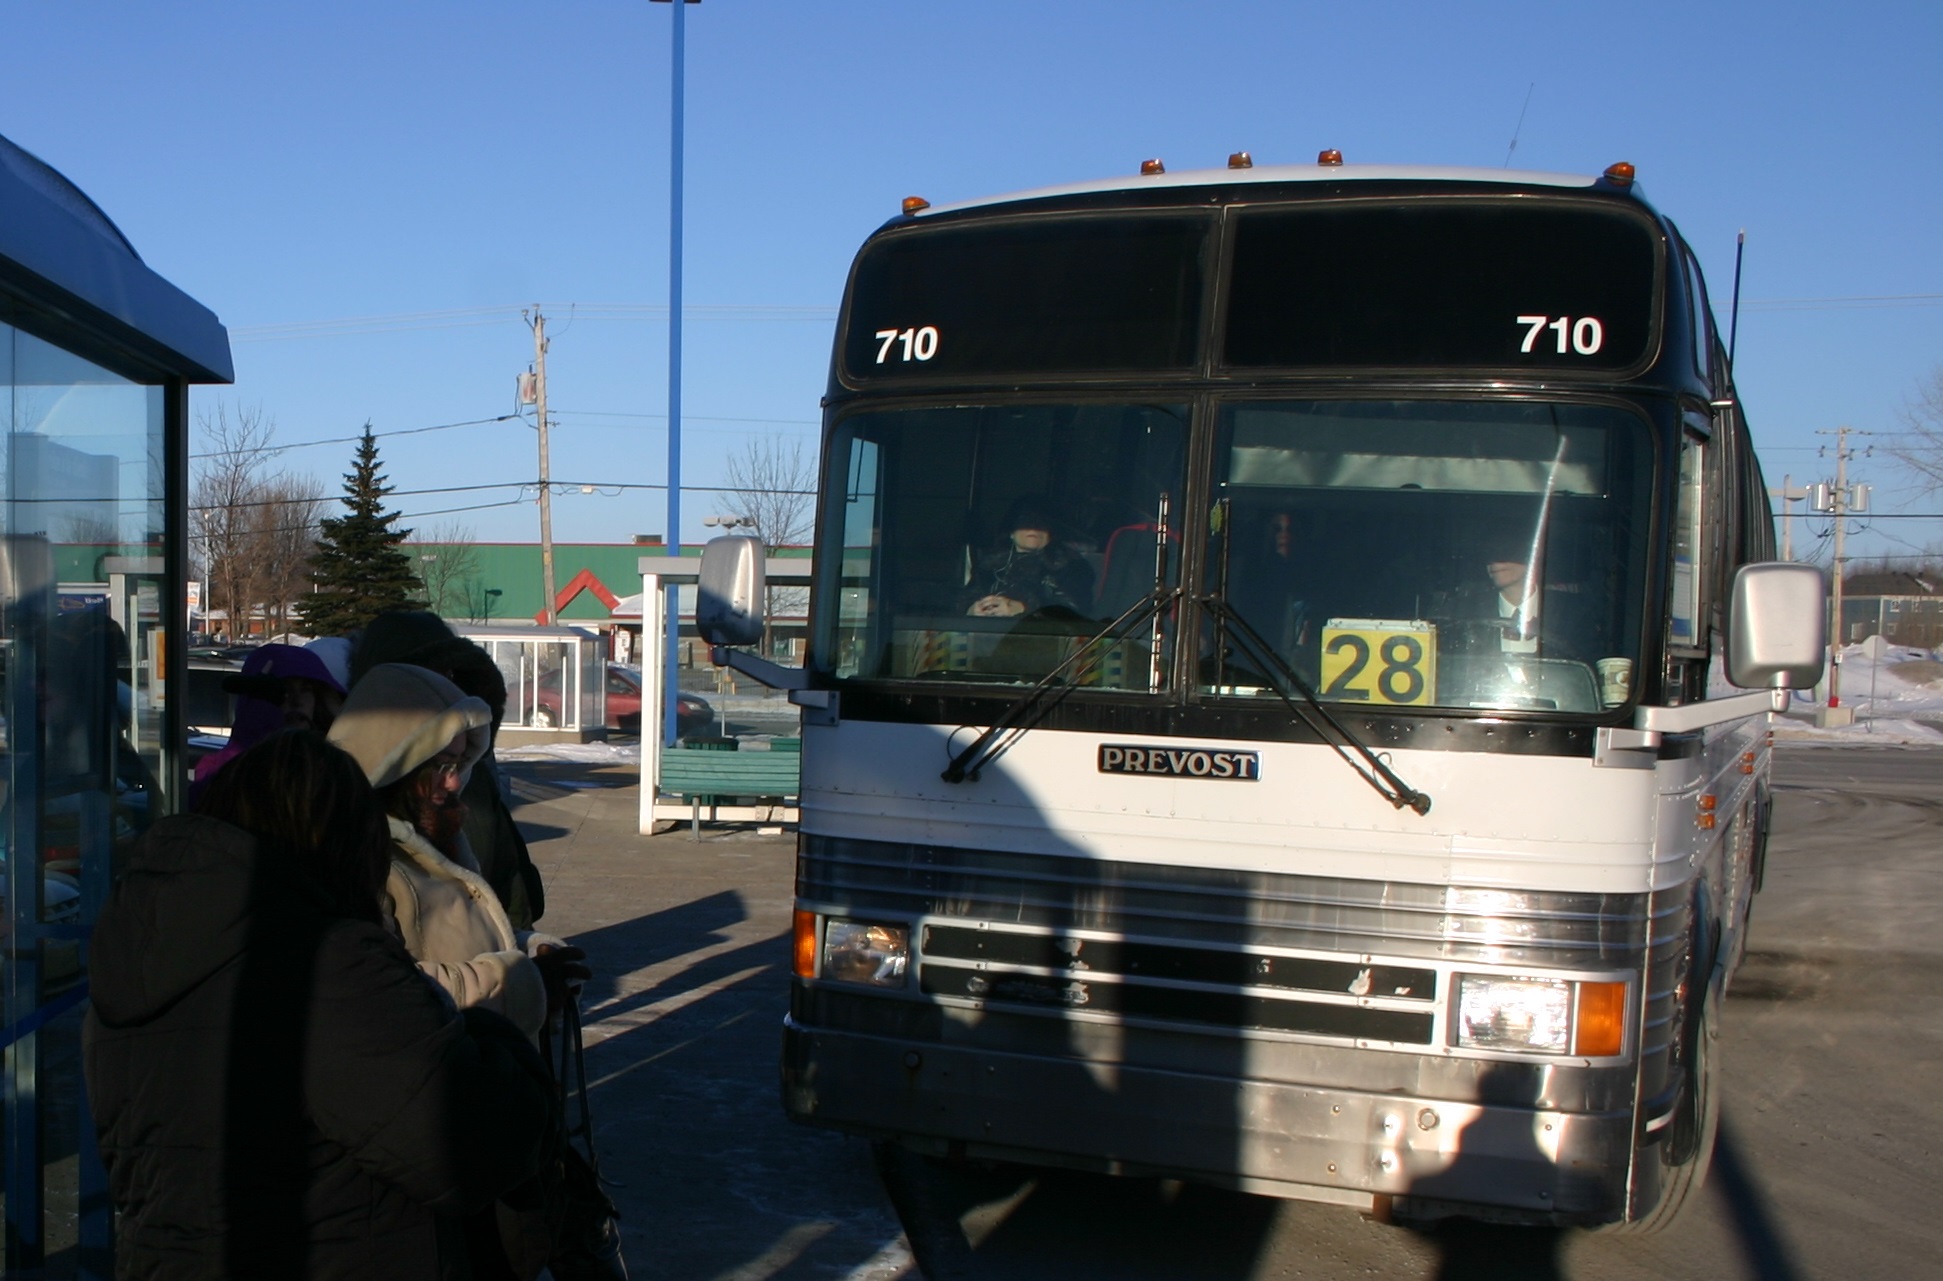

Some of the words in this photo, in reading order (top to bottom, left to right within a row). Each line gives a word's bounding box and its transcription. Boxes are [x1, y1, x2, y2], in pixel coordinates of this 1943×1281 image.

[875, 325, 939, 365] 710
[1516, 315, 1603, 356] 710
[1324, 634, 1425, 704] 28
[1102, 747, 1256, 778] PREVOST
